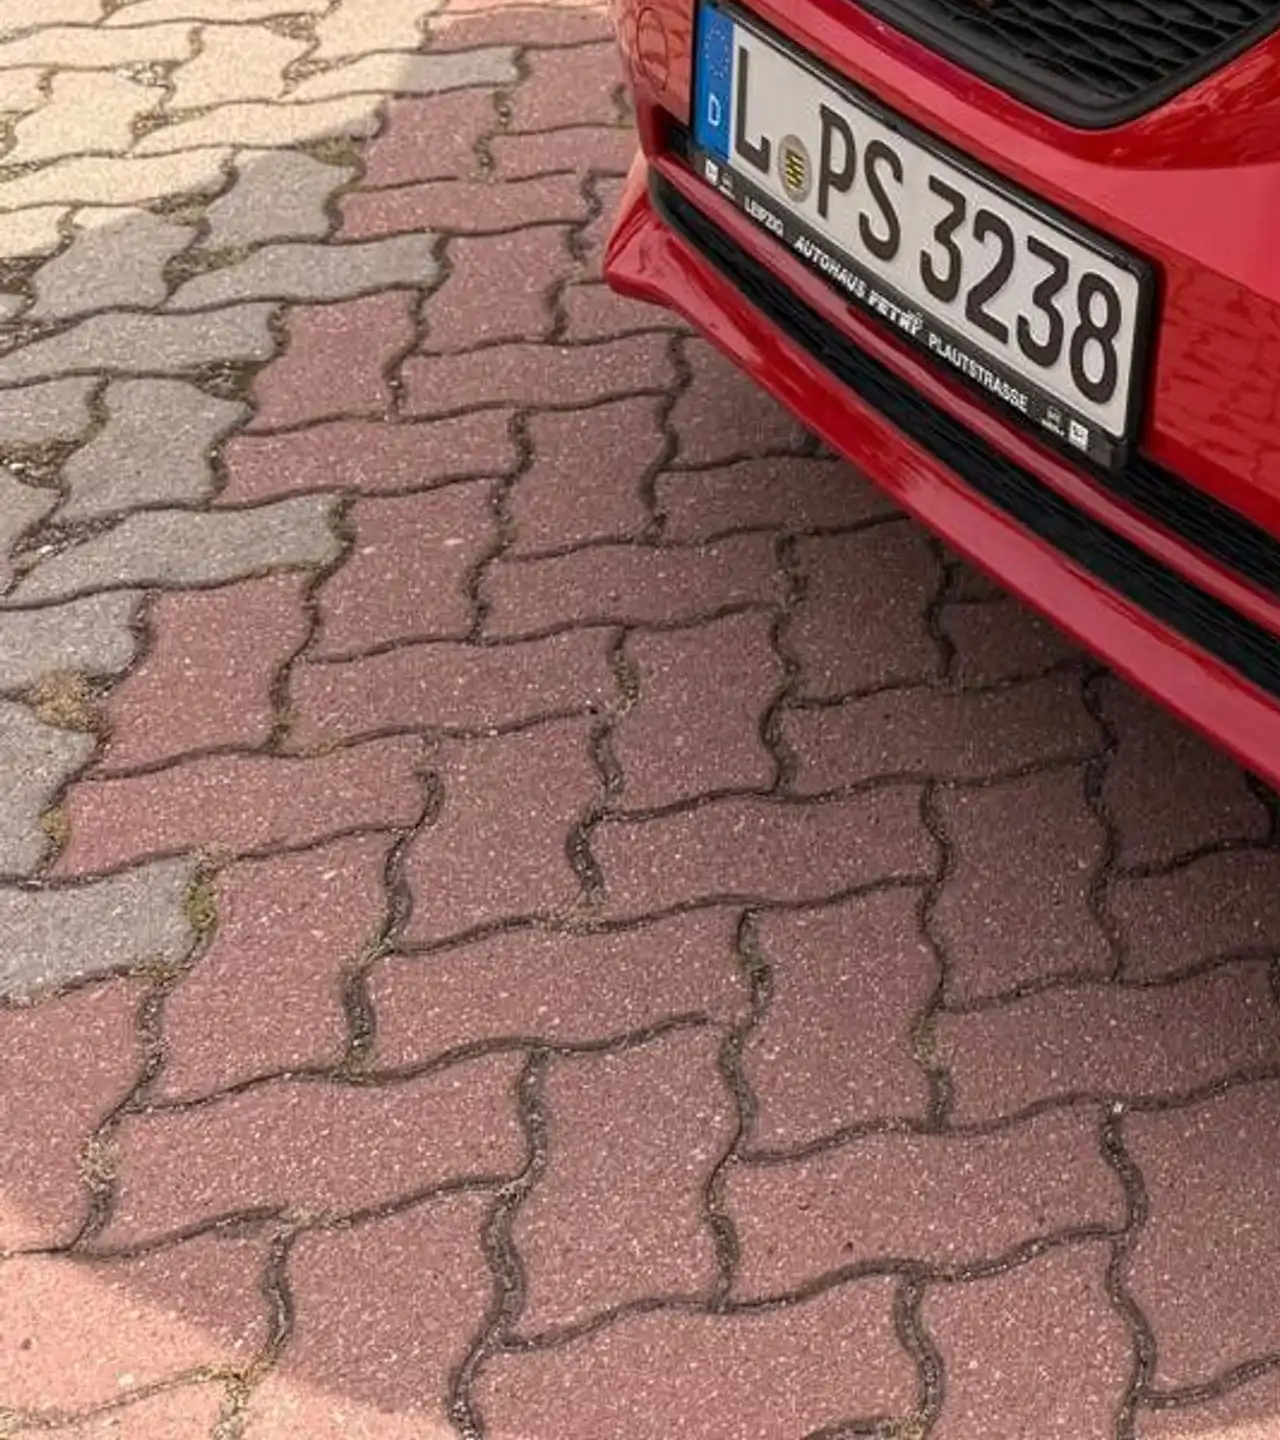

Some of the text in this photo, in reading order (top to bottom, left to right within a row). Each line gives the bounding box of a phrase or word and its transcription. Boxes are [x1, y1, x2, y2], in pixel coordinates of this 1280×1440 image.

[707, 93, 722, 127] D
[735, 46, 1121, 405] L PS 3238
[743, 196, 785, 238] LEIPZIG
[793, 236, 867, 298] AUTOHAUS
[927, 331, 1030, 415] PLAUTSTRASSE
